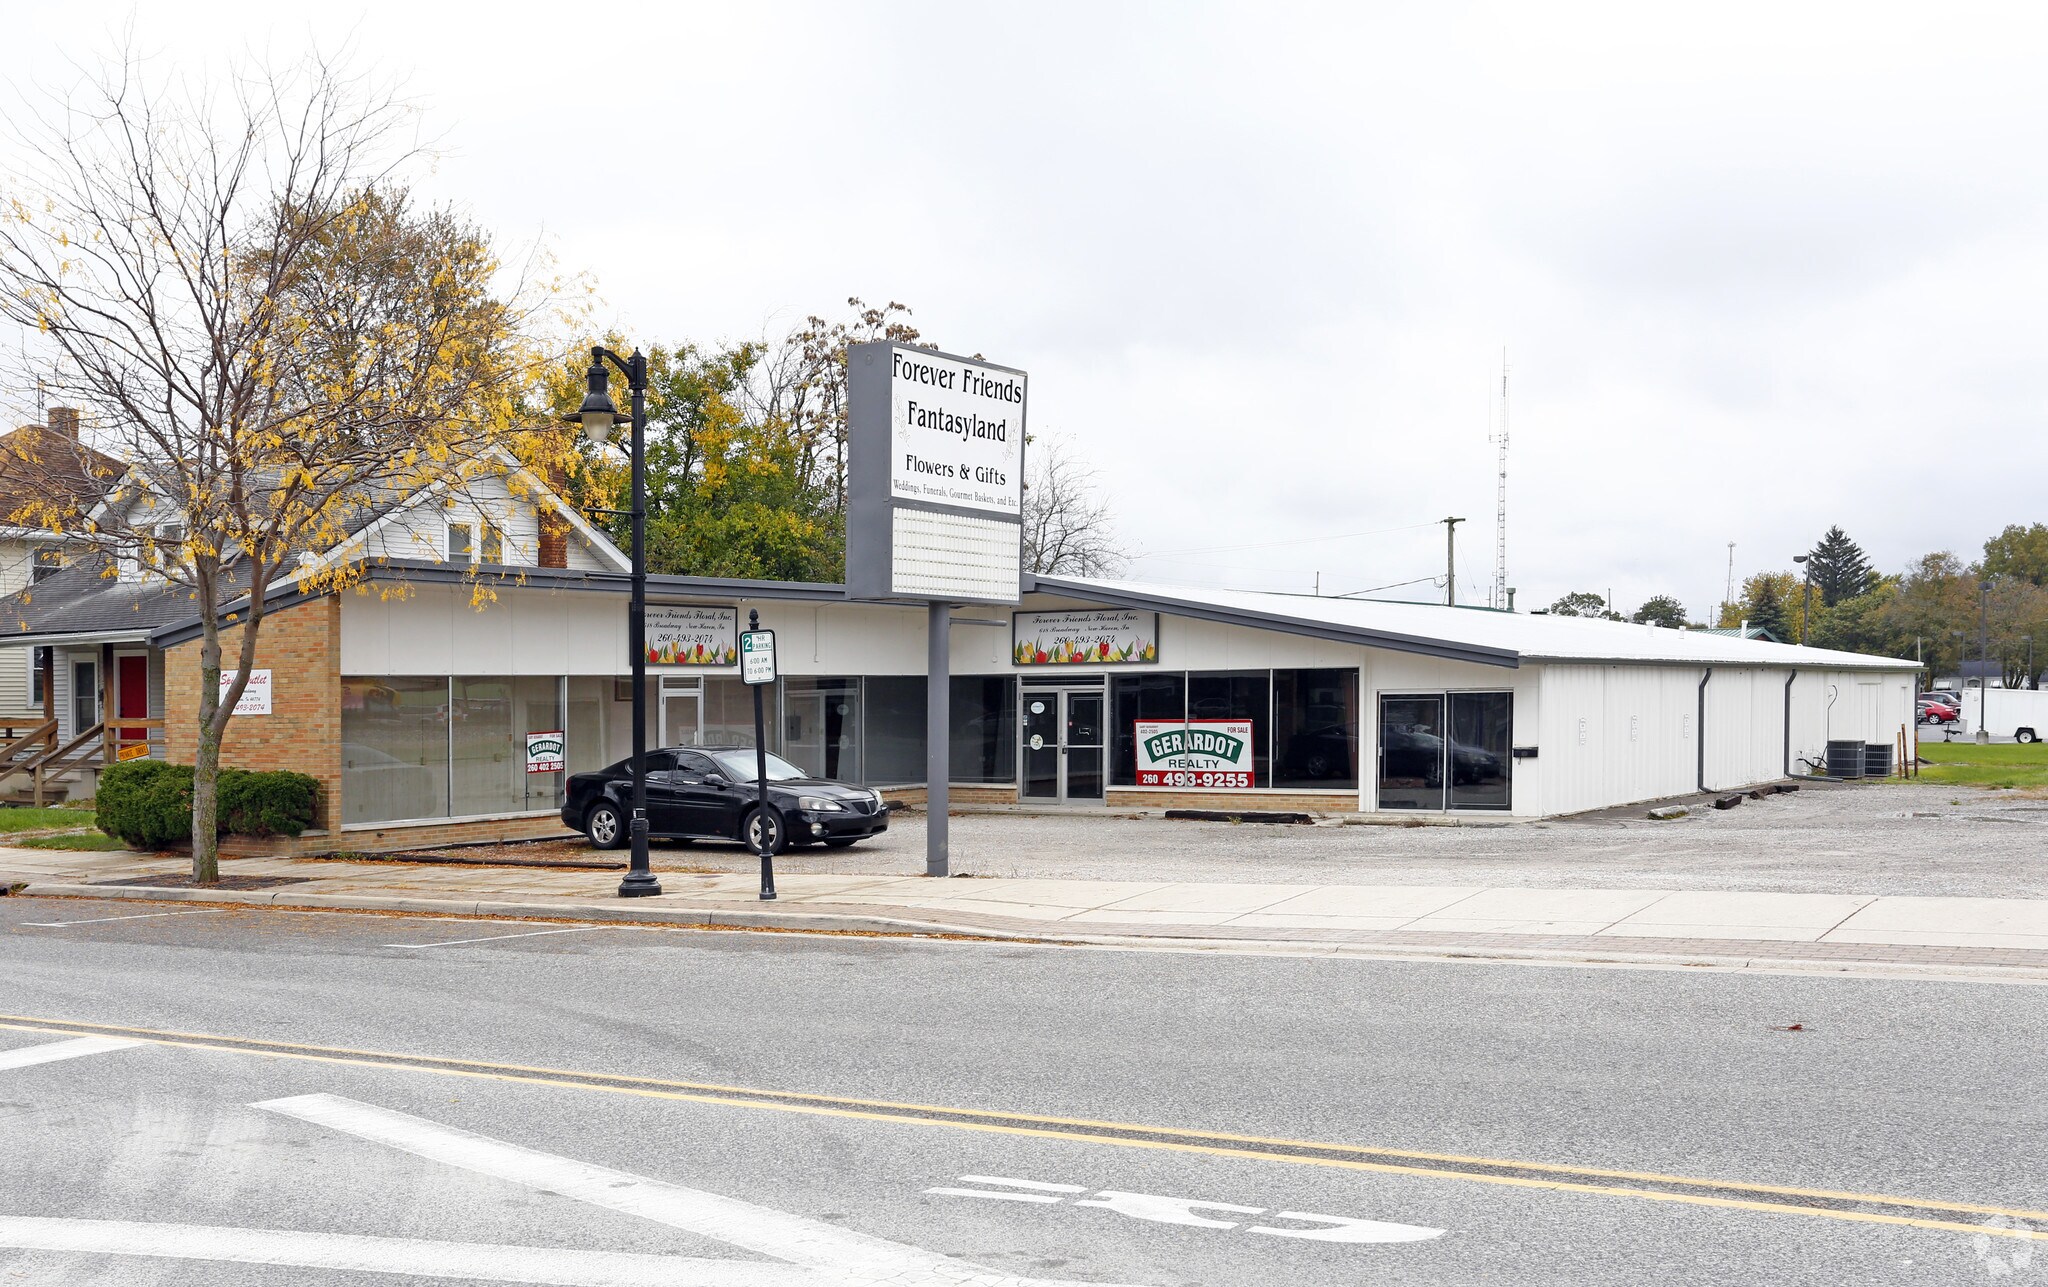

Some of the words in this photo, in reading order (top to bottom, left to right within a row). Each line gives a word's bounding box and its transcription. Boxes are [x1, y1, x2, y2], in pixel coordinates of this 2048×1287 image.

[893, 352, 956, 390] Forever
[963, 369, 1022, 404] Friends
[908, 400, 1006, 442] Fantasyland
[906, 454, 954, 478] Flowers
[959, 463, 970, 481] &
[975, 466, 1006, 486] Gifts
[949, 487, 973, 501] Gourmet
[997, 496, 1007, 506] and
[1008, 496, 1019, 507] Etc.
[665, 609, 692, 619] Friends
[717, 611, 732, 621] Inc.
[1032, 615, 1061, 624] Forever
[1062, 614, 1091, 623] Friends
[1121, 612, 1139, 621] Inc.
[658, 633, 713, 643] 260-493-2074
[744, 637, 752, 650] 2
[1053, 635, 1116, 645] 260-493-2074
[249, 675, 267, 685] utlet
[1227, 726, 1236, 734] FOR
[1237, 726, 1249, 734] SALE
[531, 742, 560, 754] GERARDOT
[1151, 733, 1237, 757] GERARDOT
[119, 750, 134, 759] PRIVATE
[136, 745, 147, 756] DRIVE
[527, 764, 538, 772] 260
[539, 763, 549, 771] 402
[550, 762, 563, 770] 2505
[1168, 759, 1220, 769] REALTY
[1142, 774, 1158, 784] 260
[1163, 773, 1248, 787] 493-9255
